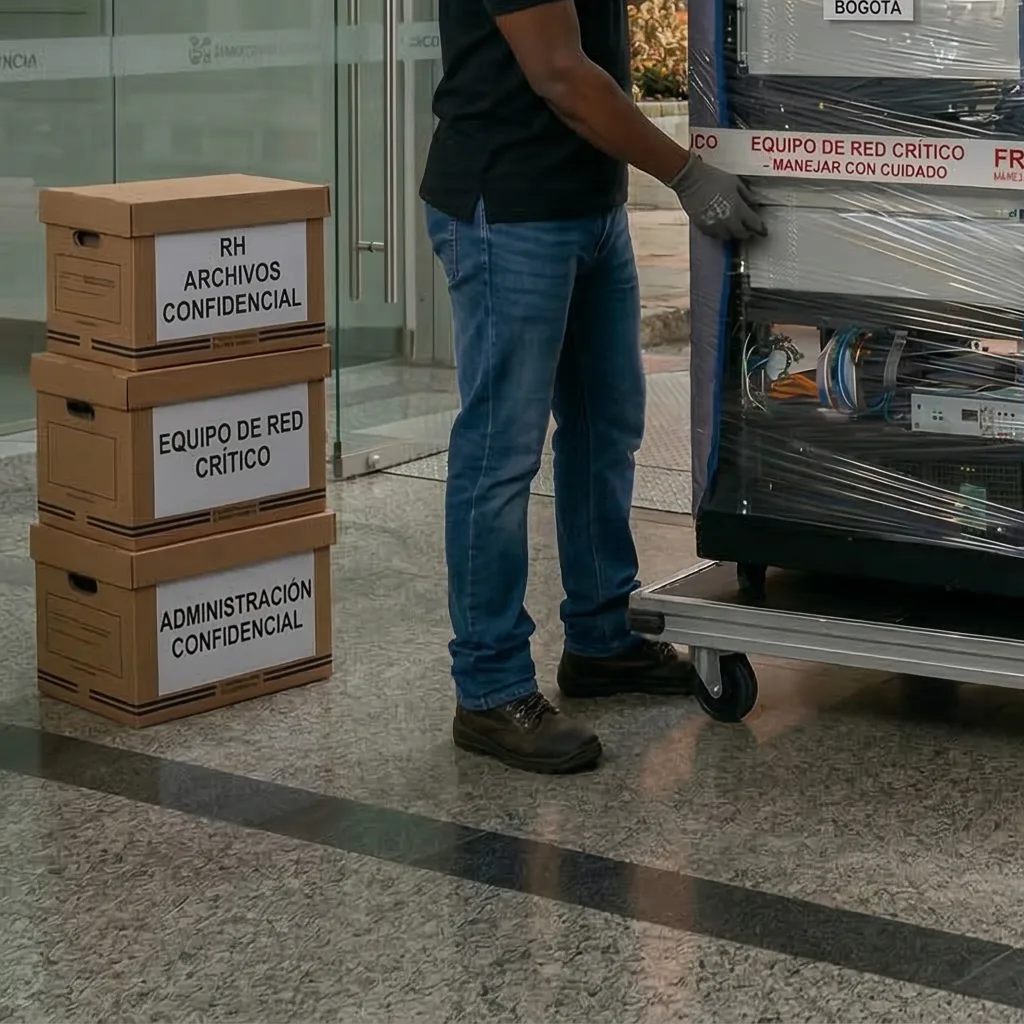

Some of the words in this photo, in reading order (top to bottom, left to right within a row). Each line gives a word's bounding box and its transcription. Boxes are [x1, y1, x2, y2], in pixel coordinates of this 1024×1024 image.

[751, 136, 816, 155] EQUIPO
[822, 140, 845, 156] DE
[850, 141, 887, 158] RED
[892, 139, 965, 161] CRÍTICO
[773, 158, 841, 174] MANEJAR
[845, 161, 876, 176] CON
[880, 162, 948, 179] CUIDADO
[220, 236, 246, 257] RH
[184, 261, 281, 291] ARCHIVOS
[162, 288, 302, 323] CONFIDENCIAL
[159, 422, 231, 455] EQUIPO
[237, 416, 262, 440] DE
[267, 409, 304, 434] RED
[195, 444, 271, 479] CRÍTICO
[160, 578, 312, 633] ADMINISTRACIÓN
[171, 609, 303, 659] CONFIDENCIAL
